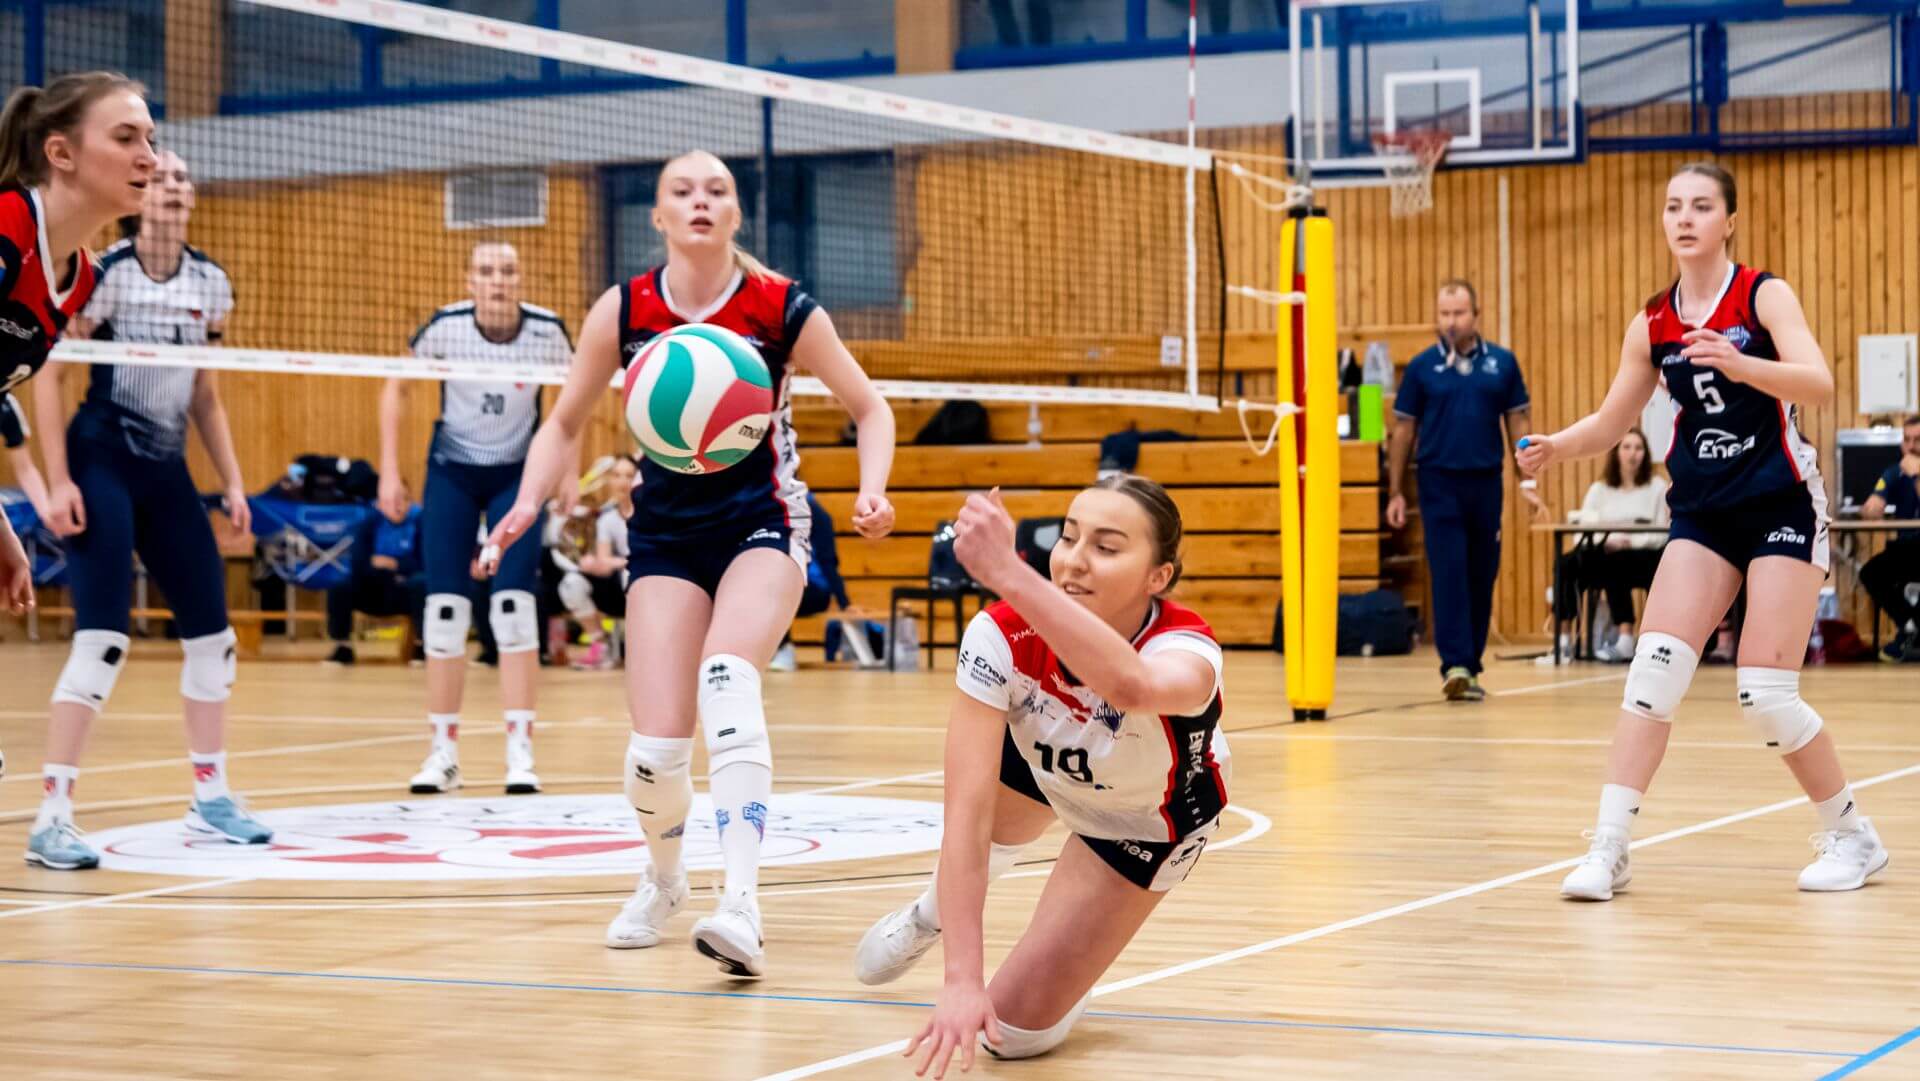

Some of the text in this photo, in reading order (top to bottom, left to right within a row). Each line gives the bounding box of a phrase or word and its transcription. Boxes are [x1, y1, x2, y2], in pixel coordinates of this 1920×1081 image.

[482, 393, 505, 415] 20
[1693, 371, 1725, 414] 5
[1698, 435, 1755, 459] Enea
[1767, 531, 1806, 544] Enea
[974, 656, 1007, 685] Enea
[1115, 839, 1153, 863] nea
